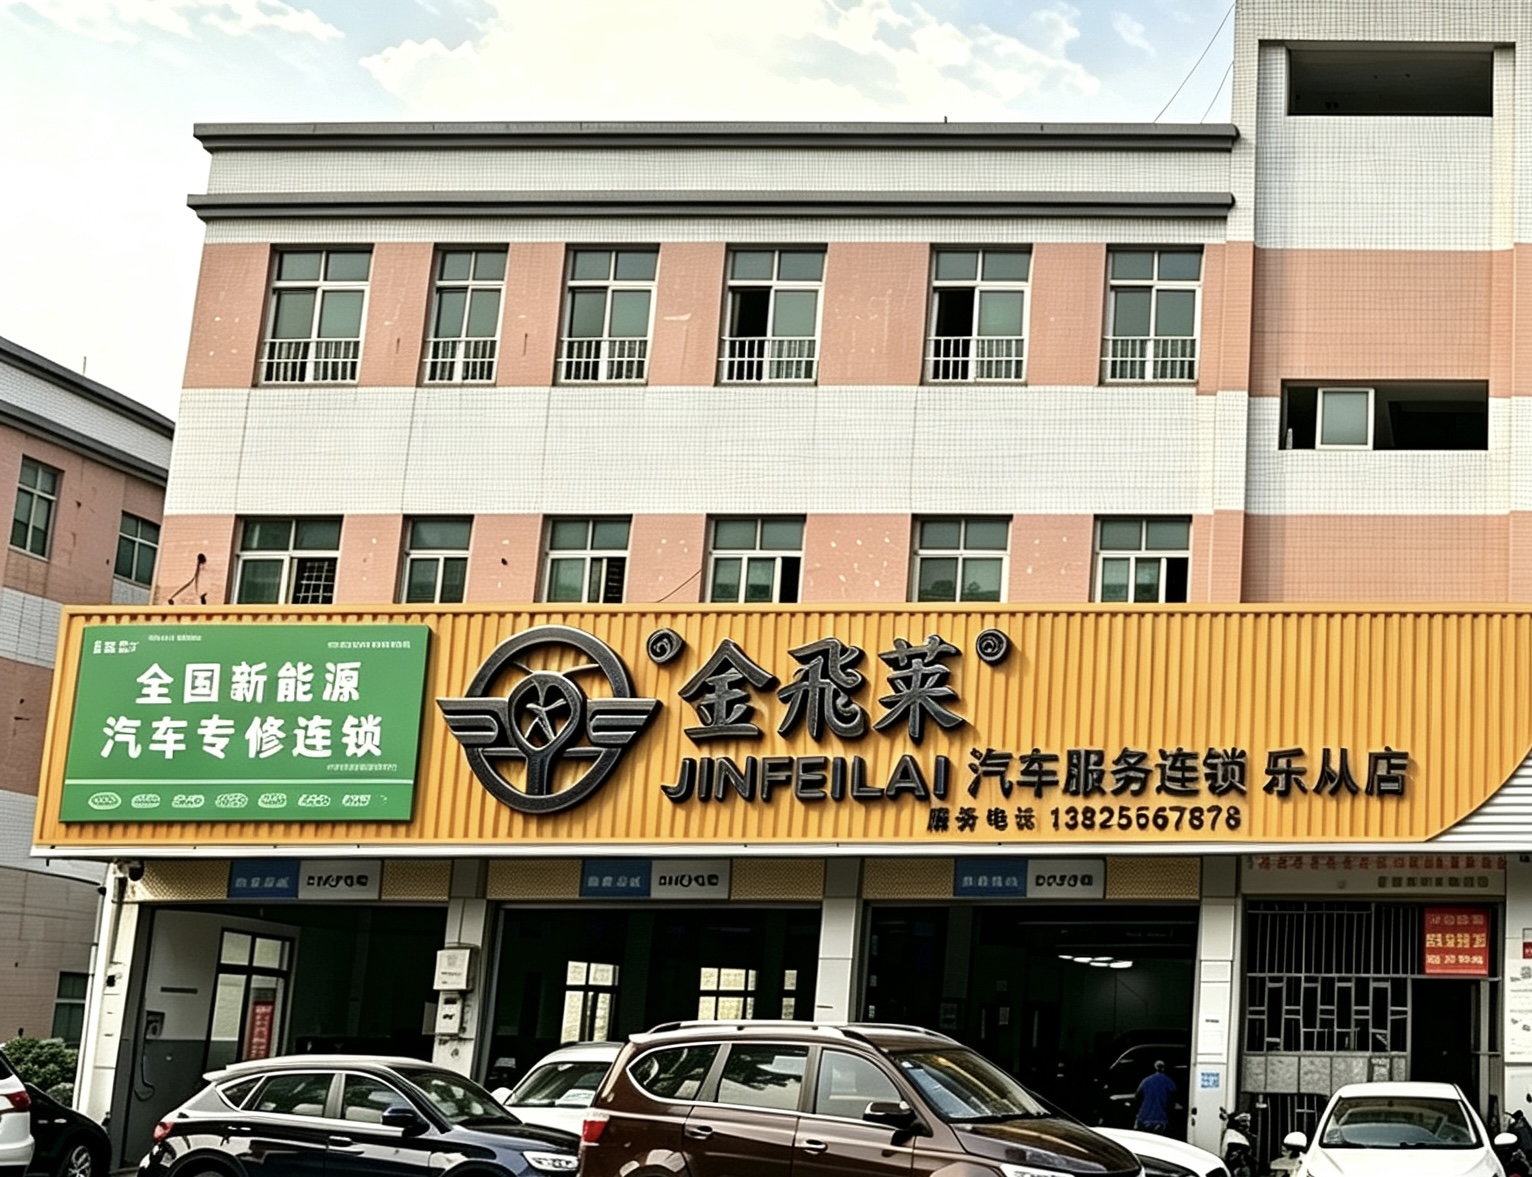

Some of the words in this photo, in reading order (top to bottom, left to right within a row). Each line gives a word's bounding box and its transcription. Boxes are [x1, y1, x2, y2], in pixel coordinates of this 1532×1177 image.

[134, 661, 361, 704] 全国新能源
[100, 714, 382, 760] 汽车专修连锁
[660, 755, 949, 803] JINFEILAI
[968, 747, 1248, 798] 汽车服务连锁
[1264, 747, 1409, 797] 乐从店
